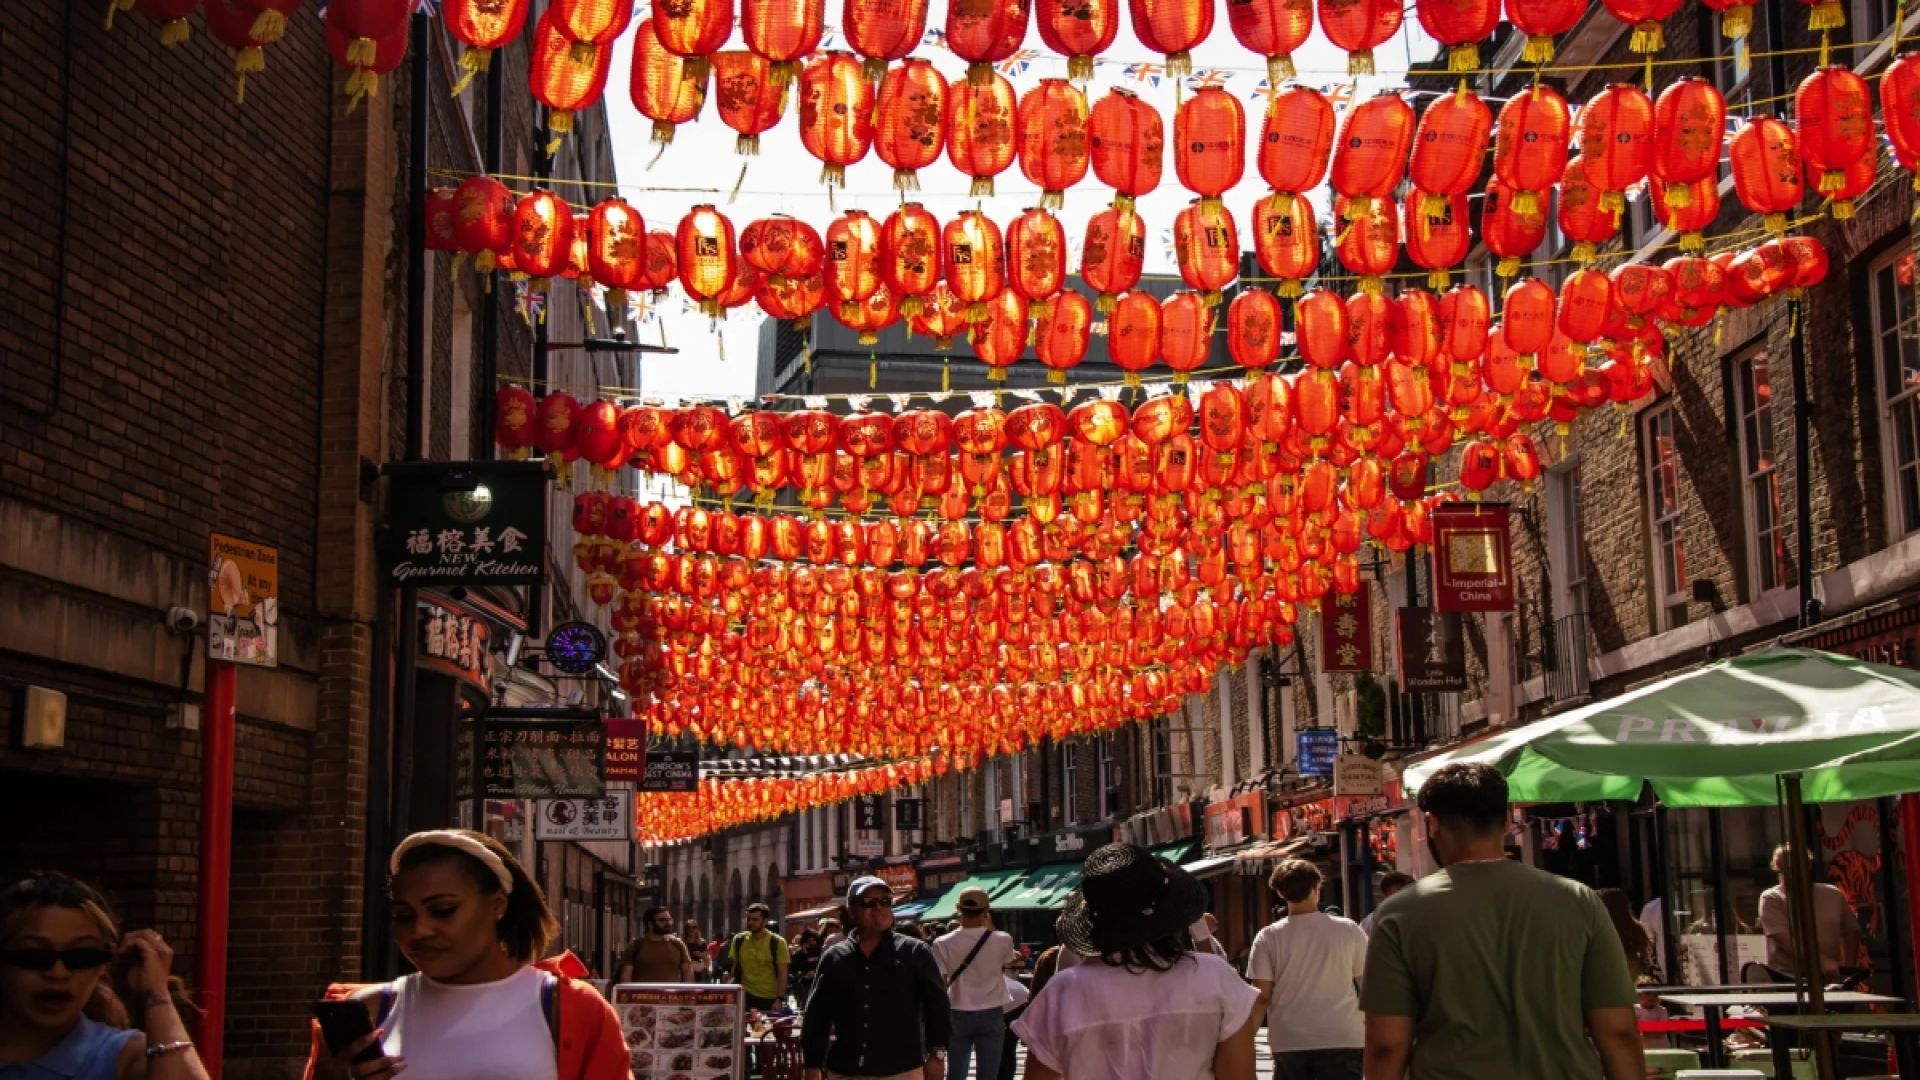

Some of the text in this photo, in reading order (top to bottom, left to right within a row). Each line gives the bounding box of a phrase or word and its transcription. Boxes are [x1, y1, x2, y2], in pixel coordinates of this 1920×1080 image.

[405, 526, 529, 555] 福榕美食
[256, 549, 276, 565] Zone
[440, 553, 477, 565] NEW
[392, 559, 540, 582] Gourmet Kitchen
[1452, 578, 1498, 589] Imperial
[1460, 591, 1492, 601] China
[1408, 676, 1463, 686] Wooden Hut
[582, 810, 618, 825] 美甲
